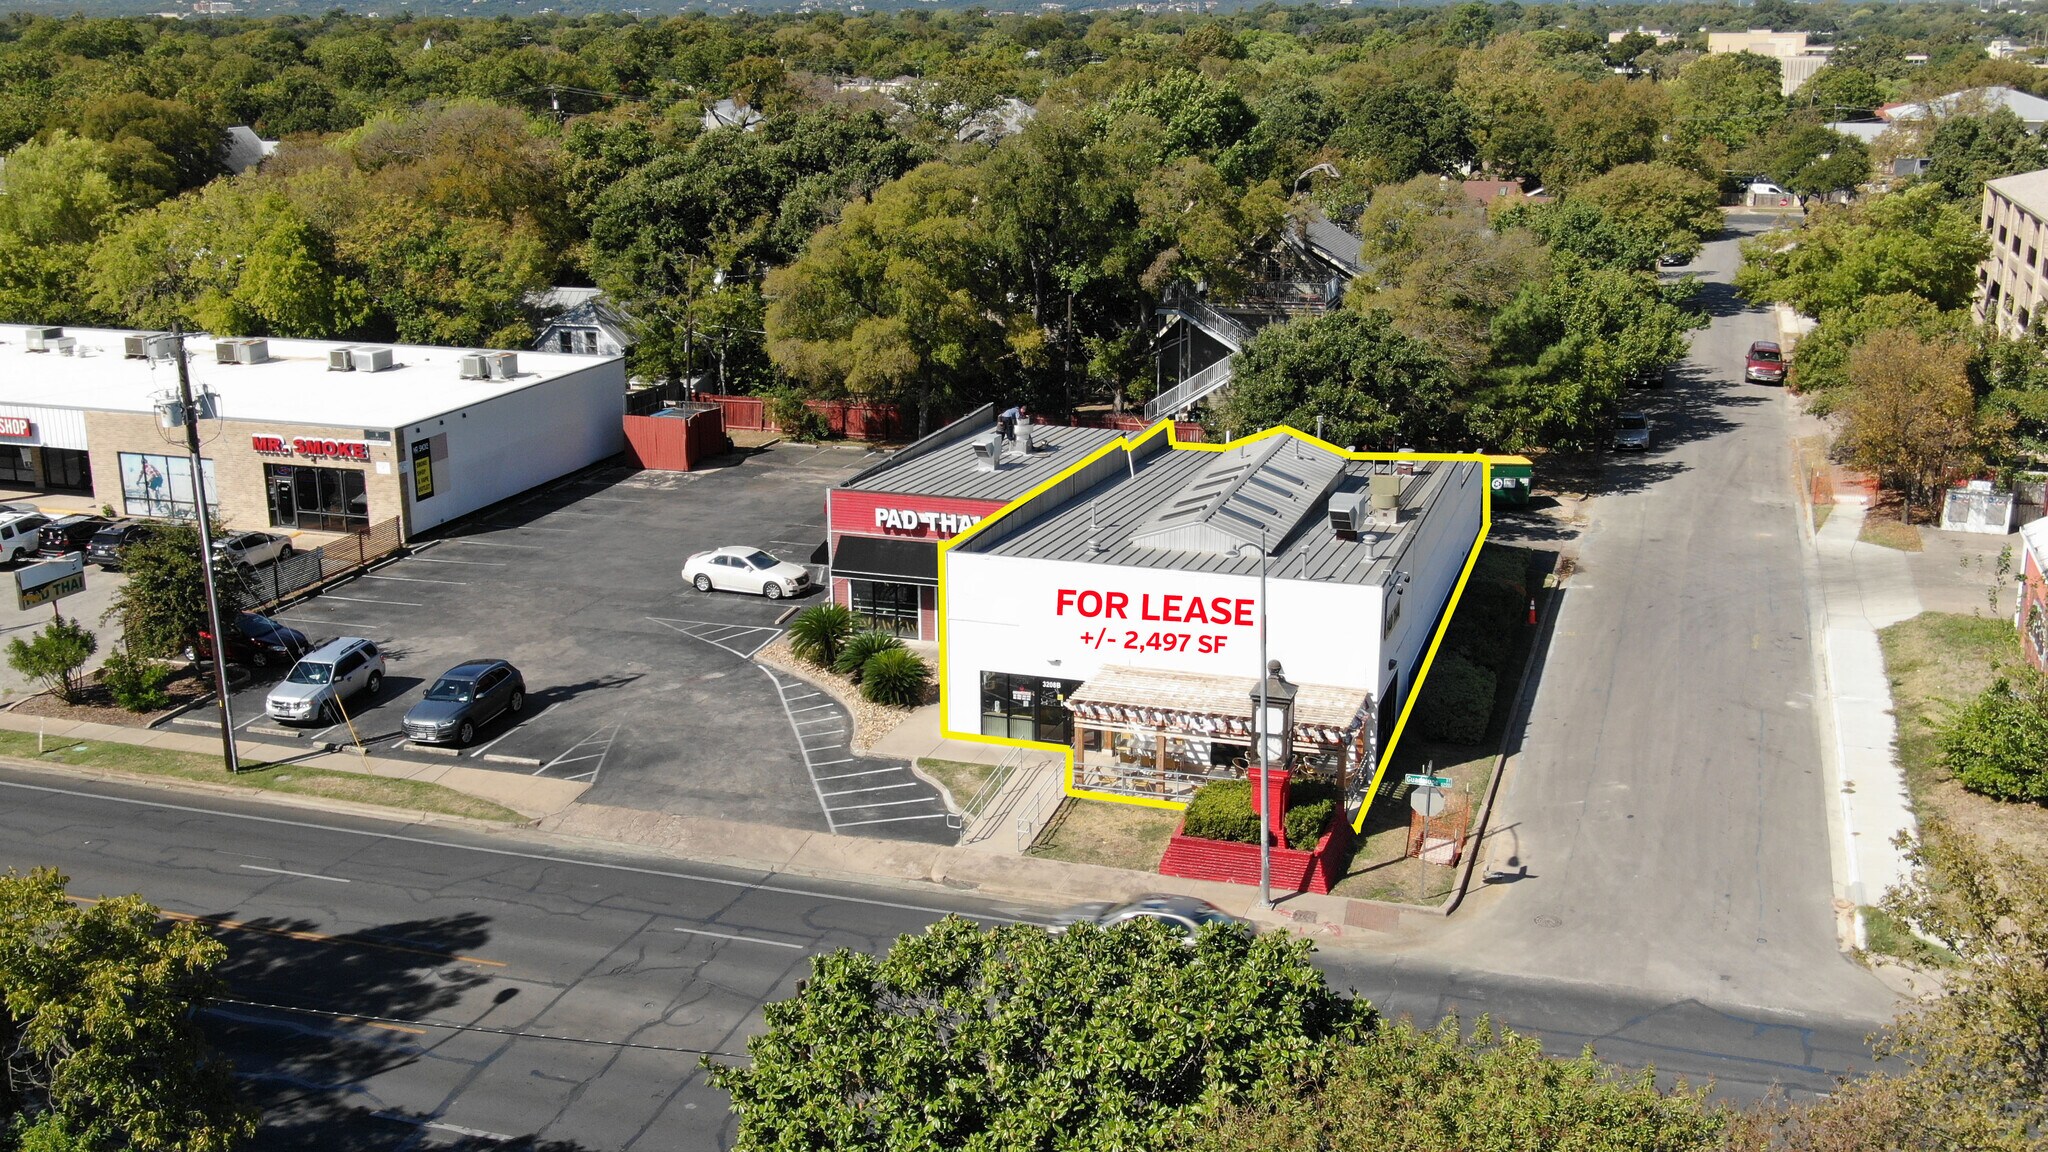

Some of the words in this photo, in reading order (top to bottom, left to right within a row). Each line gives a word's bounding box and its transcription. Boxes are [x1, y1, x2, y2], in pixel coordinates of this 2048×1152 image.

[0, 418, 27, 435] SHOP
[252, 433, 291, 453] MR.
[293, 436, 369, 459] SMOKE
[875, 508, 918, 529] PAD
[925, 511, 982, 533] THA
[53, 577, 83, 595] THAI
[1406, 775, 1440, 786] Guadupe
